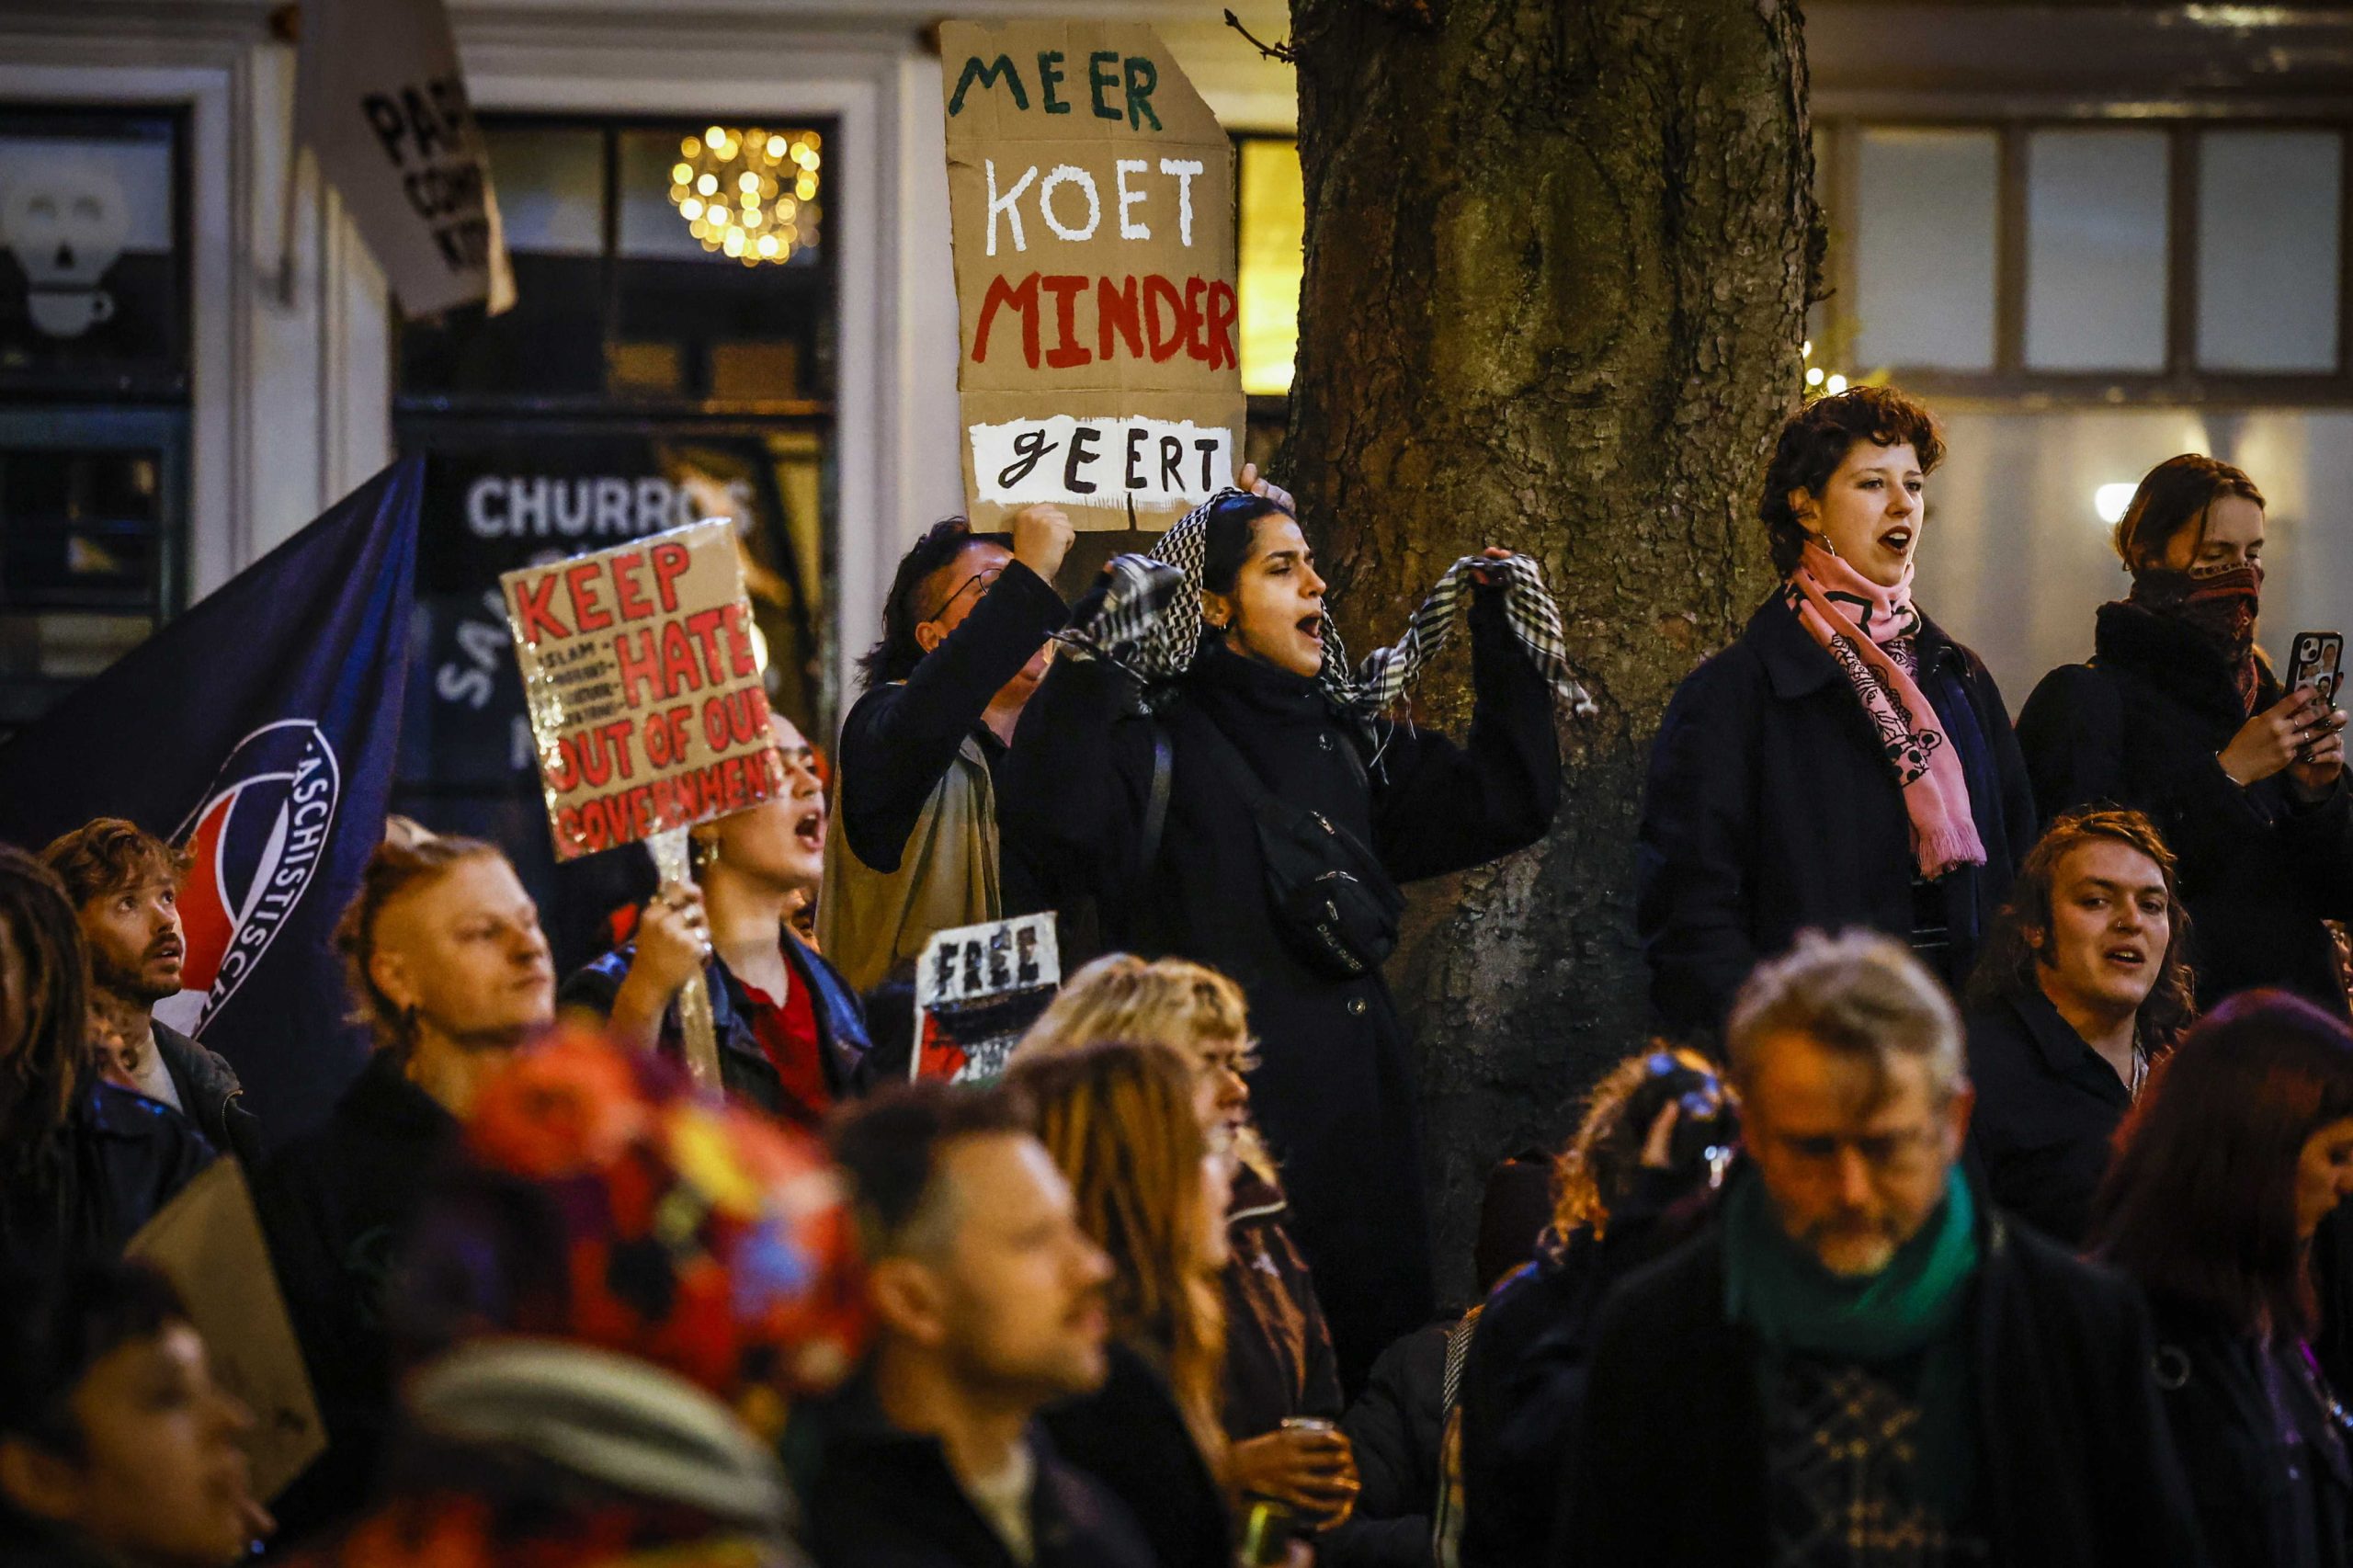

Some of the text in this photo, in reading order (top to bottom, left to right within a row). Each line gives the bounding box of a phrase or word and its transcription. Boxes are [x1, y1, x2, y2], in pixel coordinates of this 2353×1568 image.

[949, 51, 1163, 131] MEER
[985, 157, 1204, 256] KOET
[971, 270, 1239, 371] MINDER
[998, 426, 1219, 494] gEERT
[514, 542, 691, 644] KEEP
[614, 603, 756, 710] HATE
[546, 719, 634, 793] OUT
[644, 706, 692, 768] OF
[933, 926, 1040, 997] FREE
